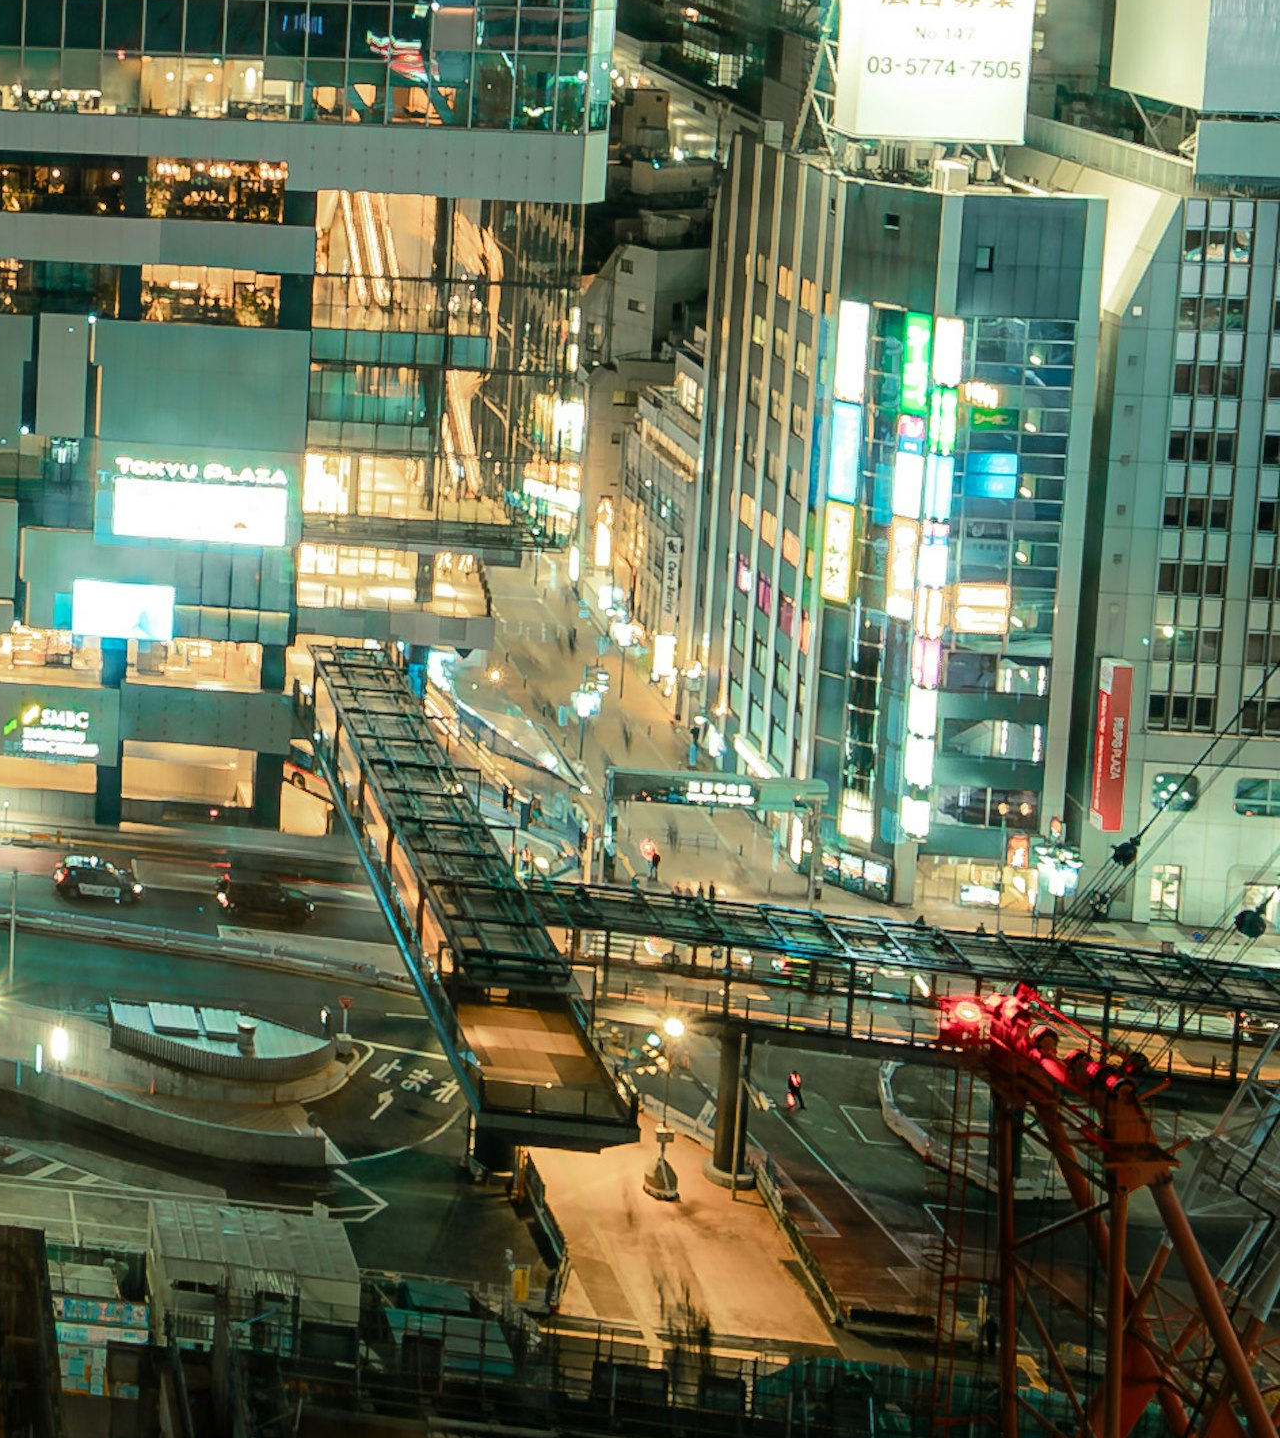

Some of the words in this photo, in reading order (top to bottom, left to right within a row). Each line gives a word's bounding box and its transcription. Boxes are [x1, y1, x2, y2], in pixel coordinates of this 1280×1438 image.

[866, 56, 1022, 79] 03-5774-7505
[114, 456, 199, 480] TOKYU
[203, 462, 289, 486] PLAZA
[40, 707, 90, 729] SMBC
[369, 1058, 460, 1104] 止まれ
